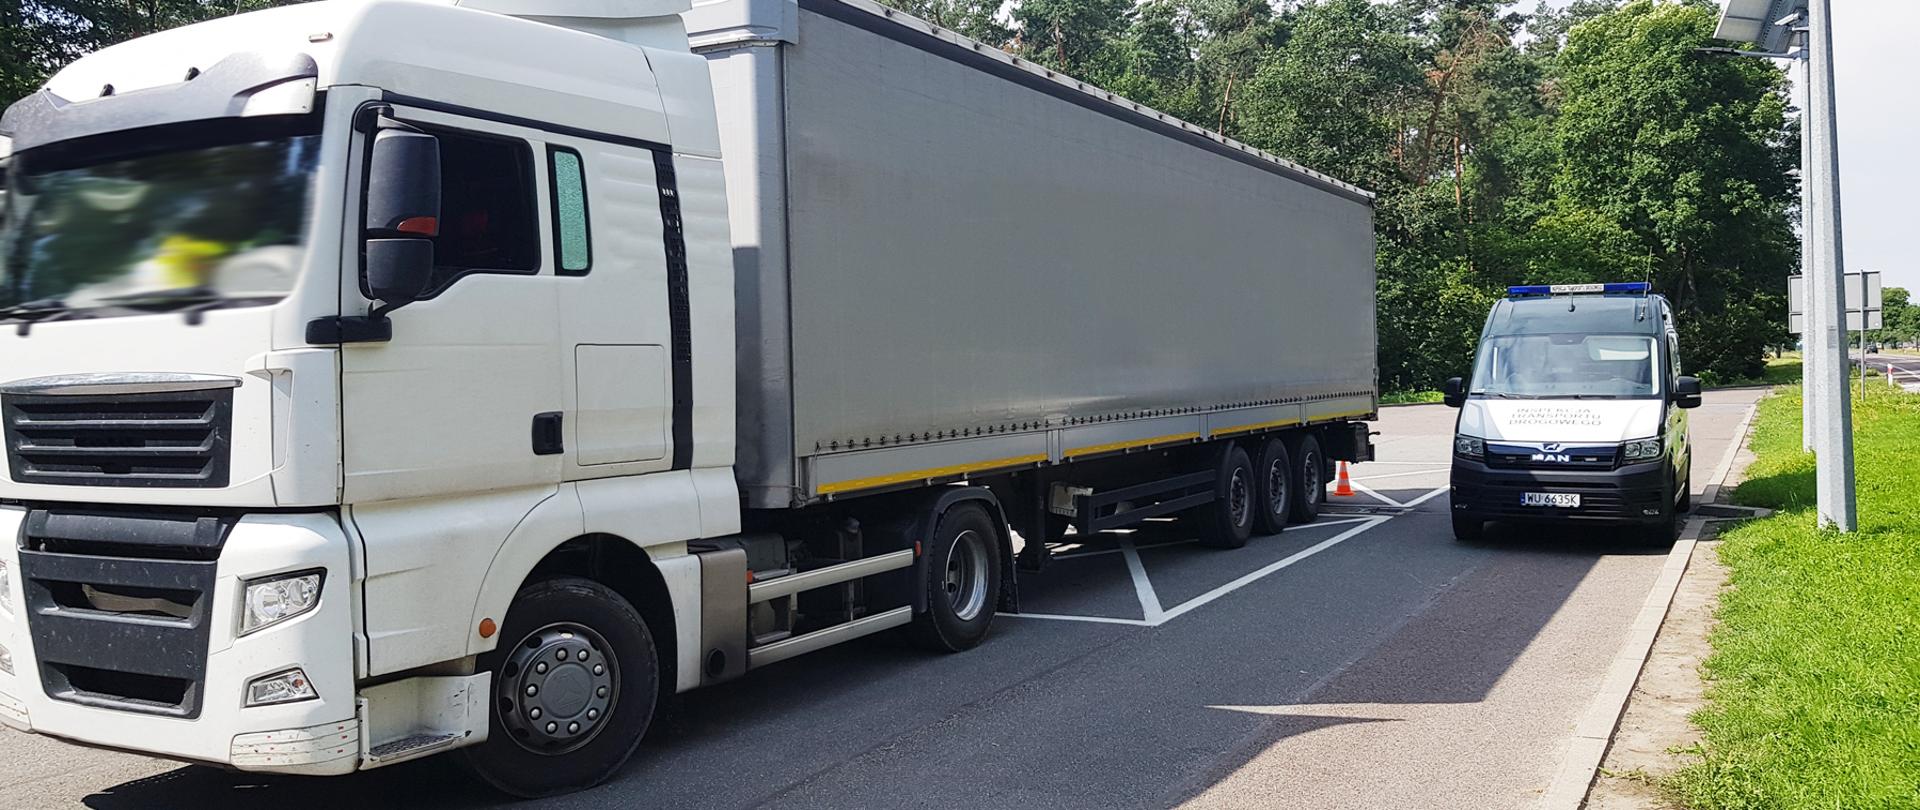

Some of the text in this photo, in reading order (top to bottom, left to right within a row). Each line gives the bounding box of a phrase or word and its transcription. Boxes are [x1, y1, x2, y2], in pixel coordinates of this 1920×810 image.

[1532, 454, 1570, 462] MAN
[1527, 493, 1577, 504] WU 6635K
